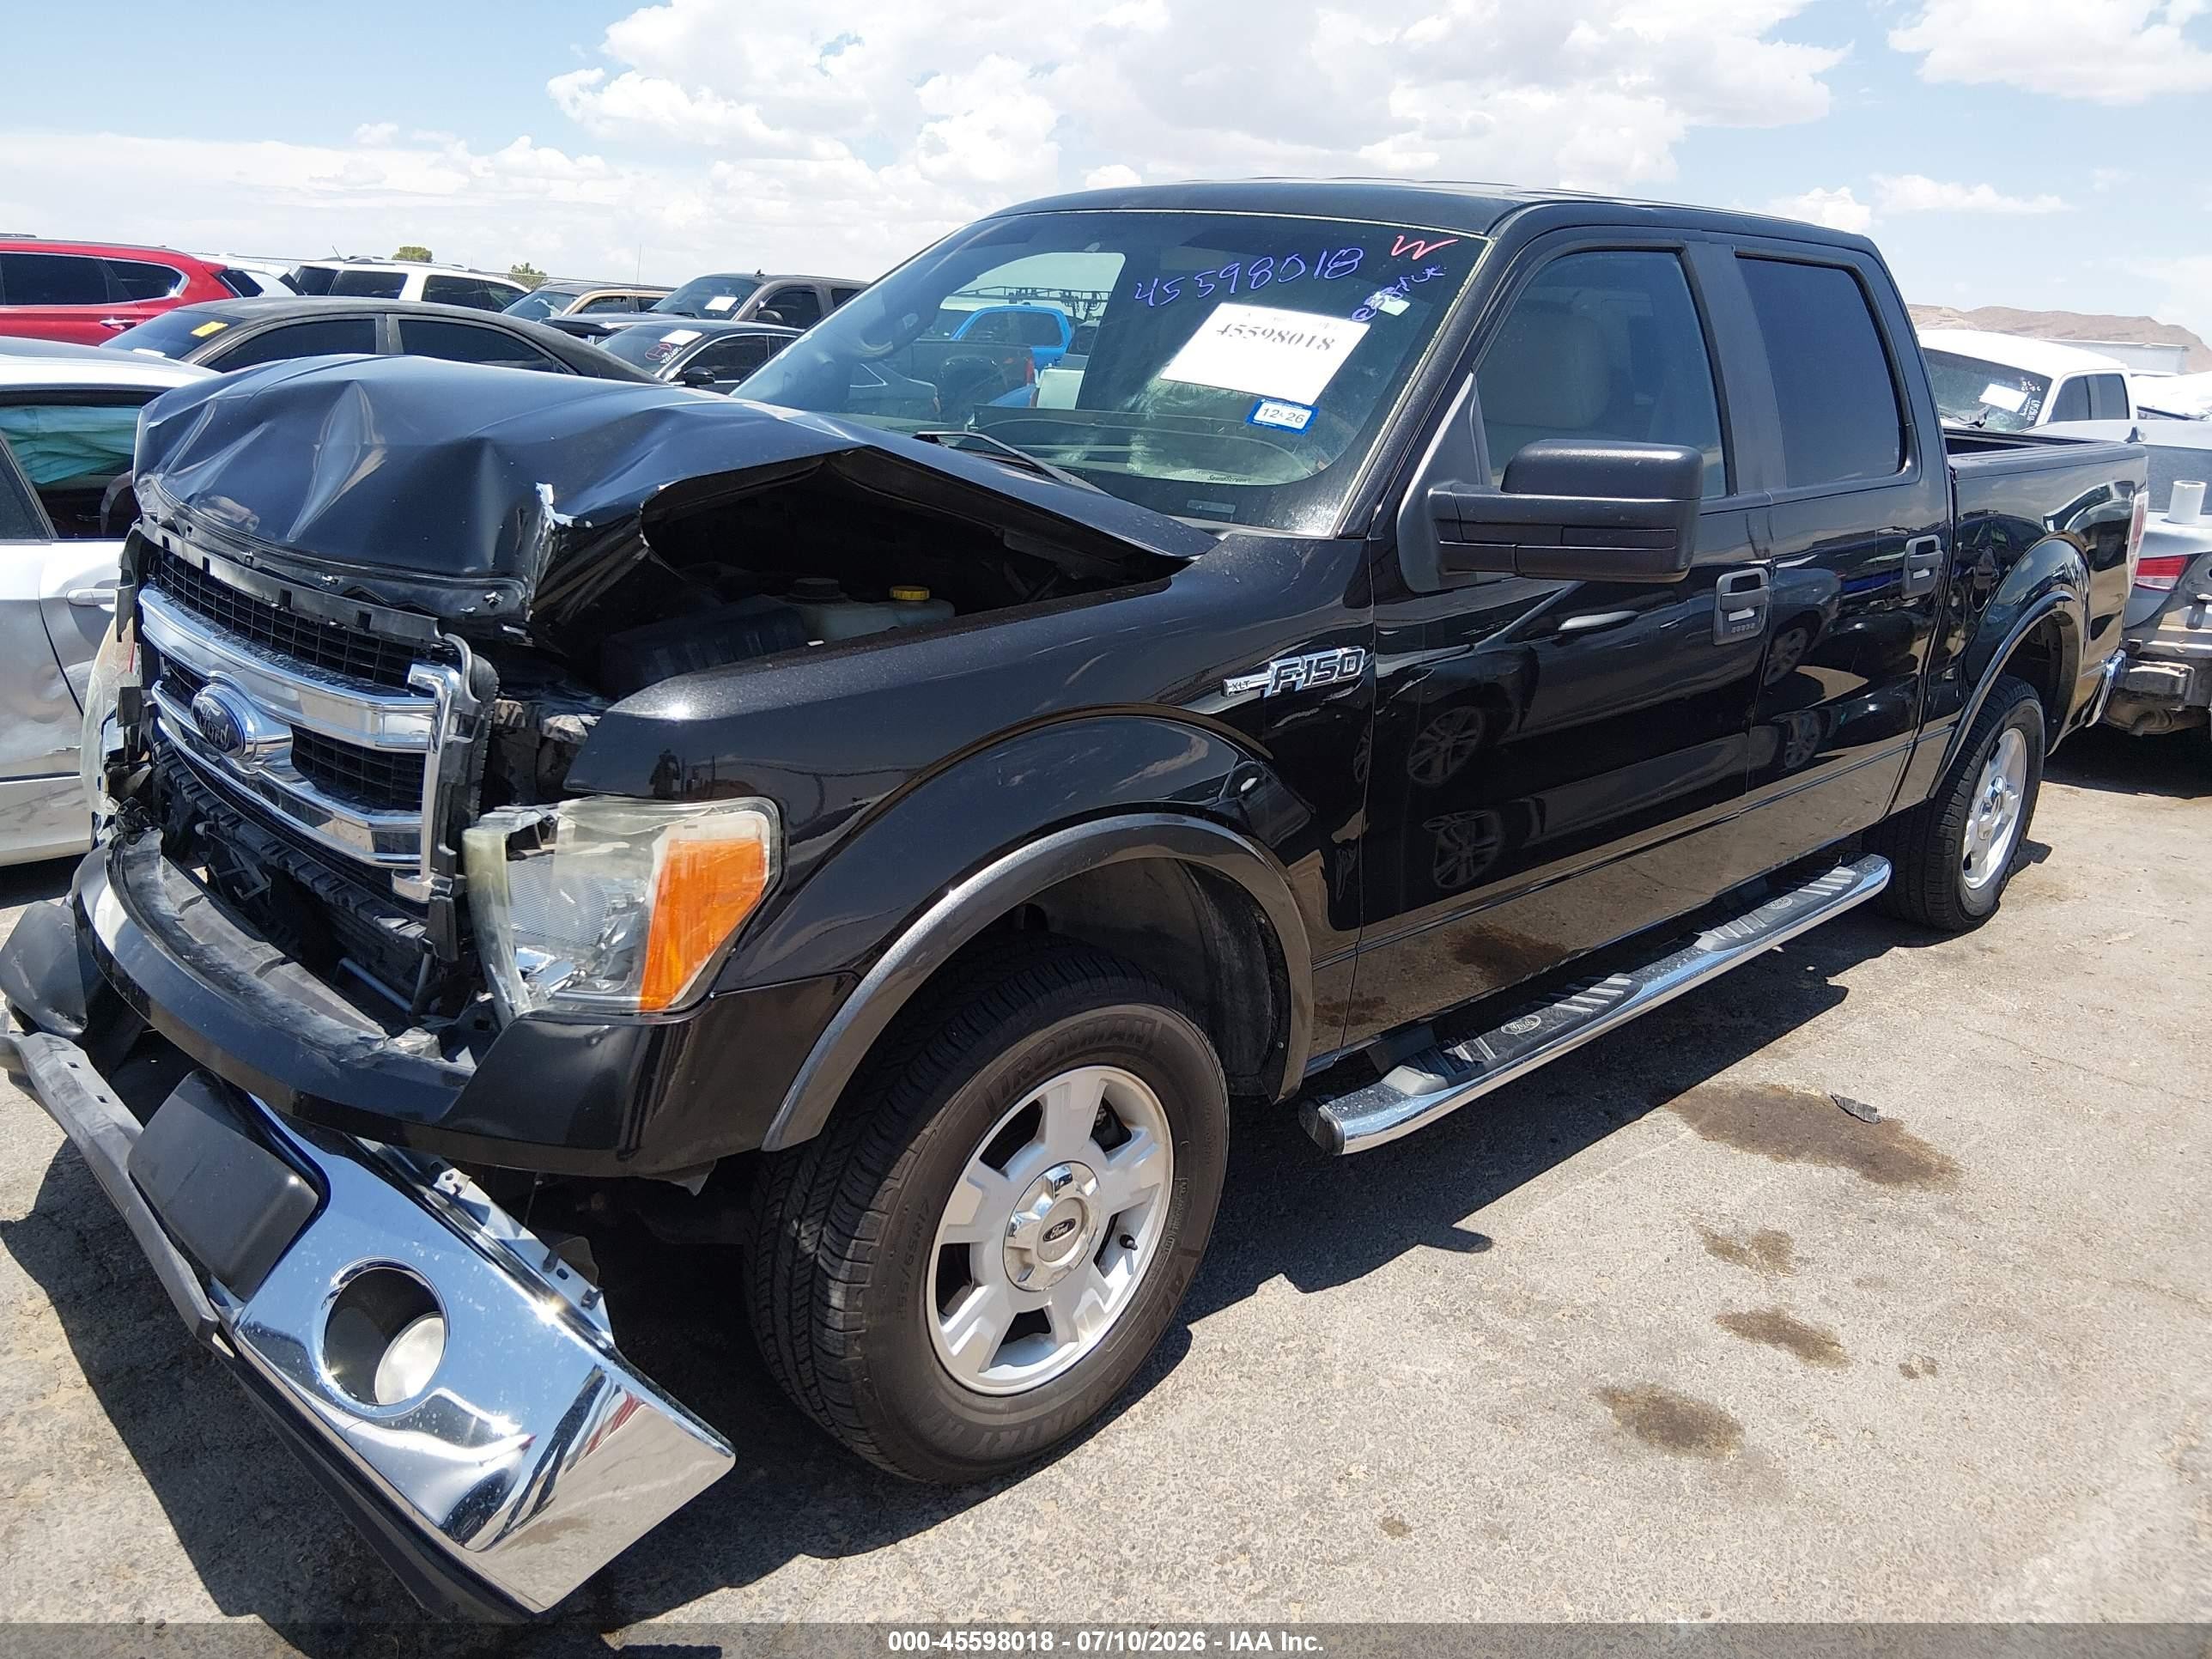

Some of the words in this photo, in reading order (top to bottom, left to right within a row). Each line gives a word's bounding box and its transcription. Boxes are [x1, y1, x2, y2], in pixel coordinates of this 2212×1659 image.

[1133, 247, 1364, 308] 45598018
[1216, 322, 1336, 351] 45598018
[1263, 407, 1279, 418] 12
[1285, 412, 1305, 423] 26
[1231, 680, 1250, 690] XLT
[1264, 646, 1365, 698] F-150
[197, 695, 231, 750] Ford
[1002, 1018, 1158, 1096] IRONMAN
[1050, 1222, 1071, 1239] Ford
